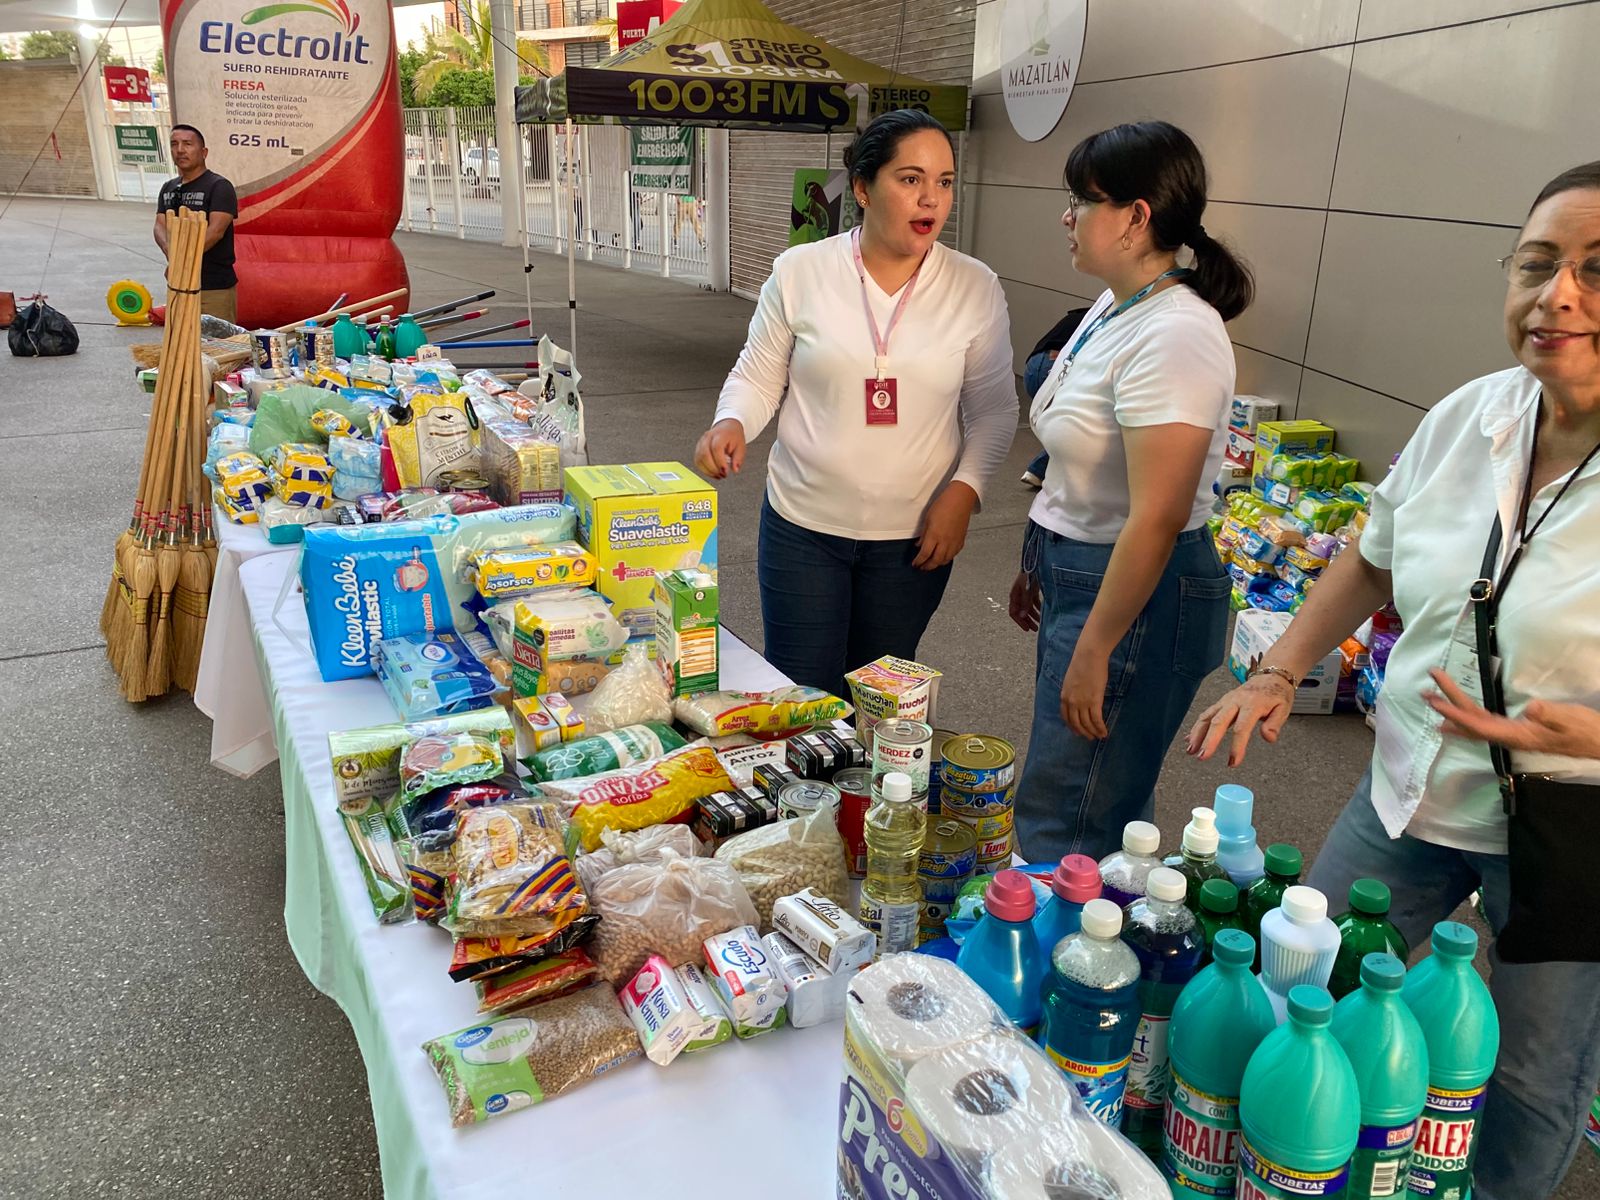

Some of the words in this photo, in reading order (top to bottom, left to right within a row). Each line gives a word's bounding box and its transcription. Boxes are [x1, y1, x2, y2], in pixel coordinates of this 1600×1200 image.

[622, 28, 646, 39] PUERTA
[199, 20, 369, 65] Electrolit
[728, 37, 822, 56] STEREO
[732, 49, 831, 70] UNO
[223, 62, 261, 74] SUERO
[265, 65, 349, 80] REHIDRATANTE
[1008, 54, 1071, 88] MAZATLÁN
[125, 74, 139, 94] 3
[223, 79, 265, 92] FRESA
[224, 91, 259, 101] Solución
[261, 92, 308, 103] esterilizada
[870, 87, 931, 102] STEREO
[225, 100, 234, 108] de
[235, 101, 275, 110] electrolitos
[276, 102, 298, 111] orales
[225, 108, 255, 117] indicada
[257, 111, 273, 120] para
[274, 112, 303, 121] prevenir
[233, 117, 253, 125] tratar
[254, 118, 262, 126] la
[263, 119, 314, 129] deshidratación
[228, 133, 261, 147] 625
[266, 135, 290, 148] mL
[640, 126, 668, 141] SALIDA
[668, 125, 681, 140] DE
[636, 142, 688, 158] EMERGENCIA
[685, 500, 712, 512] 648
[609, 522, 690, 542] Suavelastic
[854, 685, 894, 709] Maruchan
[731, 714, 750, 724] Arroz
[729, 750, 777, 767] Arroz
[878, 743, 911, 758] HERDEZ
[583, 770, 666, 804] TEXANO
[613, 792, 650, 804] FRIJOL
[984, 840, 1008, 855] Tuny
[727, 939, 761, 975] Escudo
[650, 986, 671, 1020] Rosa
[640, 994, 661, 1033] Venus
[1064, 1060, 1098, 1074] AROMA
[1427, 1095, 1474, 1107] CUBETAS
[886, 1097, 905, 1134] 6
[1169, 1144, 1238, 1178] RENDIDO
[1174, 1170, 1187, 1186] 3
[1186, 1179, 1216, 1195] VECES
[1270, 1172, 1326, 1191] CUBETAS
